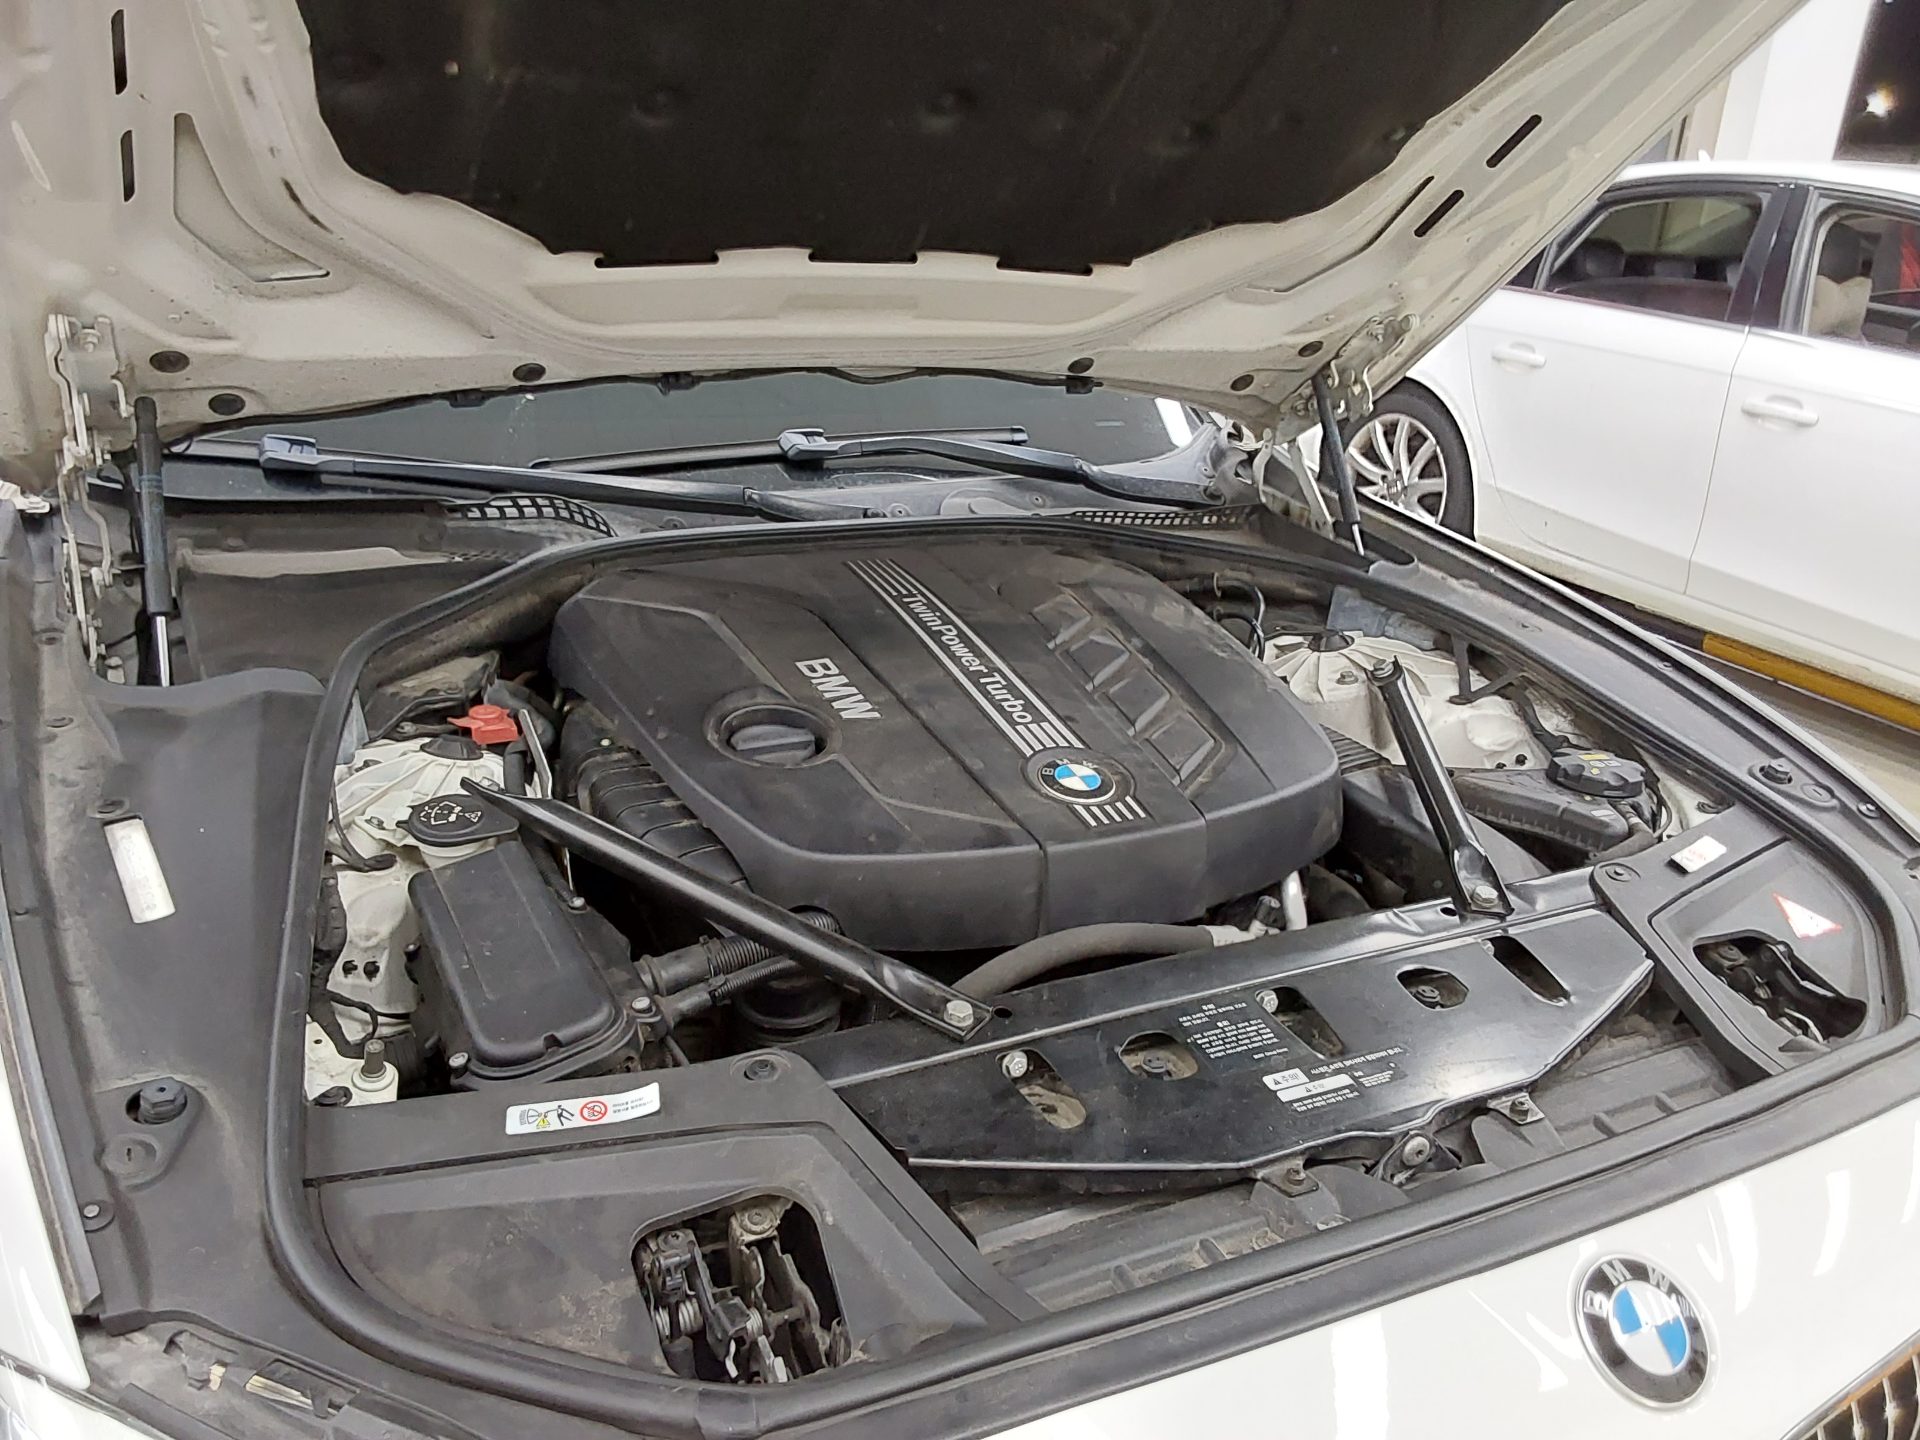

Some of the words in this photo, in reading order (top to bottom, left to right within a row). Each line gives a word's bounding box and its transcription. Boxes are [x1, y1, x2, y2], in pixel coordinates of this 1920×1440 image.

[902, 592, 988, 672] TwinPower
[979, 672, 1032, 722] Turbo
[795, 658, 881, 719] BMW
[1584, 1258, 1672, 1319] BMW
